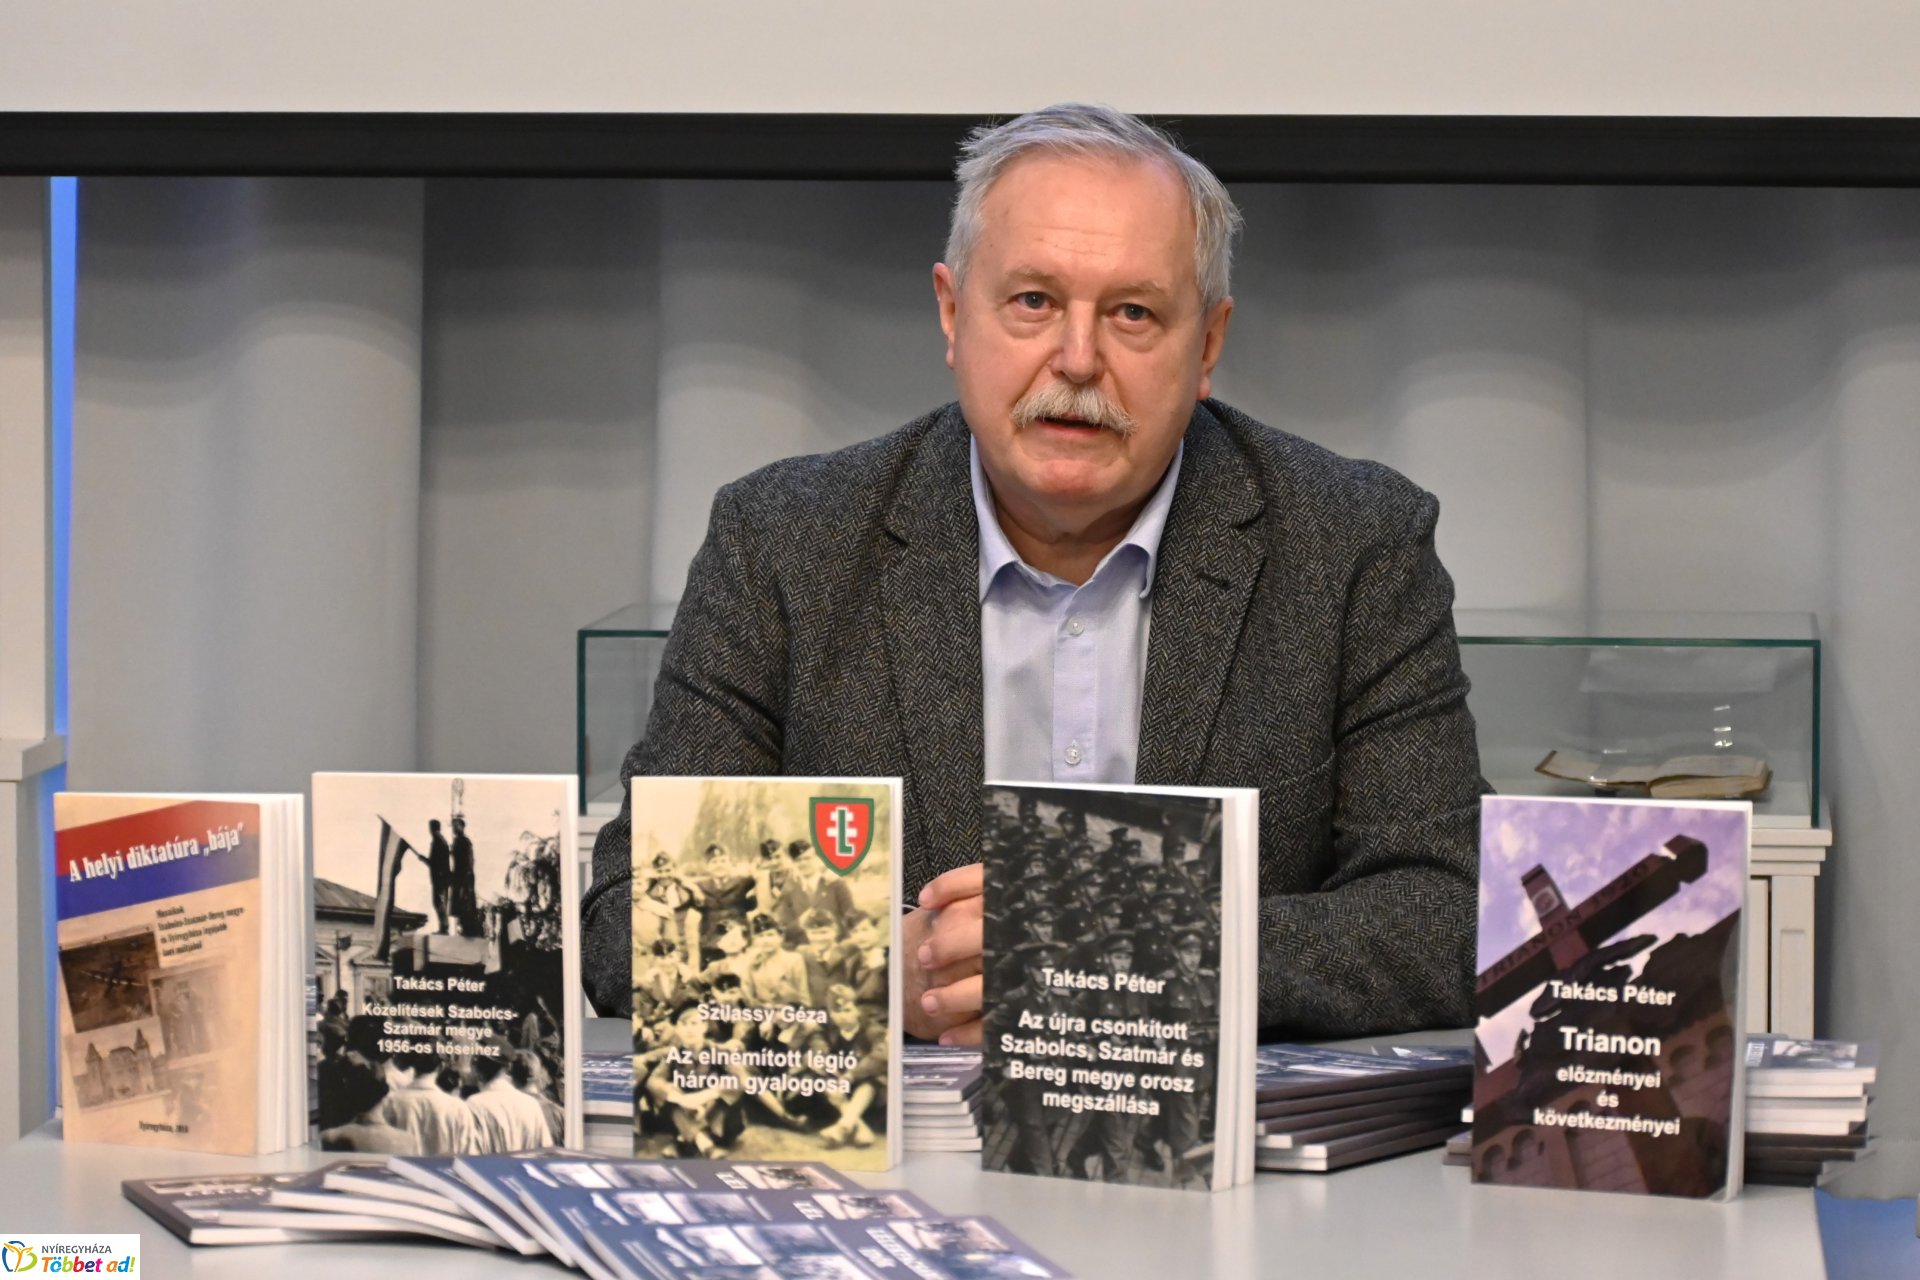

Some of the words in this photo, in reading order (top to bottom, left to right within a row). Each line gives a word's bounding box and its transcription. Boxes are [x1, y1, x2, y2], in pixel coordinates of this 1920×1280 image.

[69, 859, 82, 882] A
[83, 850, 125, 880] helyi
[126, 835, 199, 869] diktatúra
[394, 975, 444, 991] Takács
[447, 976, 486, 992] Péter
[1041, 967, 1109, 991] Takács
[1114, 972, 1166, 994] Péter
[1550, 980, 1618, 1003] Takács
[1623, 985, 1676, 1006] Péter
[362, 1002, 444, 1018] Közelítések
[448, 1004, 519, 1021] Szabolcs-
[780, 1004, 828, 1024] Géza
[383, 1022, 443, 1037] Szatmár
[445, 1025, 493, 1040] megye
[1018, 1010, 1043, 1030] Az
[1049, 1011, 1086, 1034] újra
[1091, 1017, 1188, 1041] csonkított
[377, 1039, 432, 1054] 1956-os
[436, 1041, 500, 1057] hőseihez
[1001, 1033, 1093, 1060] Szabolcs,
[1099, 1041, 1177, 1066] Szatmár
[1181, 1049, 1205, 1068] és
[1559, 1026, 1661, 1057] Trianon
[666, 1047, 693, 1065] Az
[698, 1047, 802, 1068] elnémított
[807, 1051, 857, 1070] légió
[673, 1070, 738, 1090] három
[744, 1073, 850, 1097] gyalogosa
[1010, 1061, 1067, 1087] Bereg
[1072, 1071, 1136, 1091] megye
[1140, 1075, 1195, 1093] orosz
[1556, 1065, 1661, 1090] előzményei
[1042, 1090, 1160, 1116] megszállása
[1597, 1090, 1619, 1108] és
[1533, 1108, 1680, 1138] következményei
